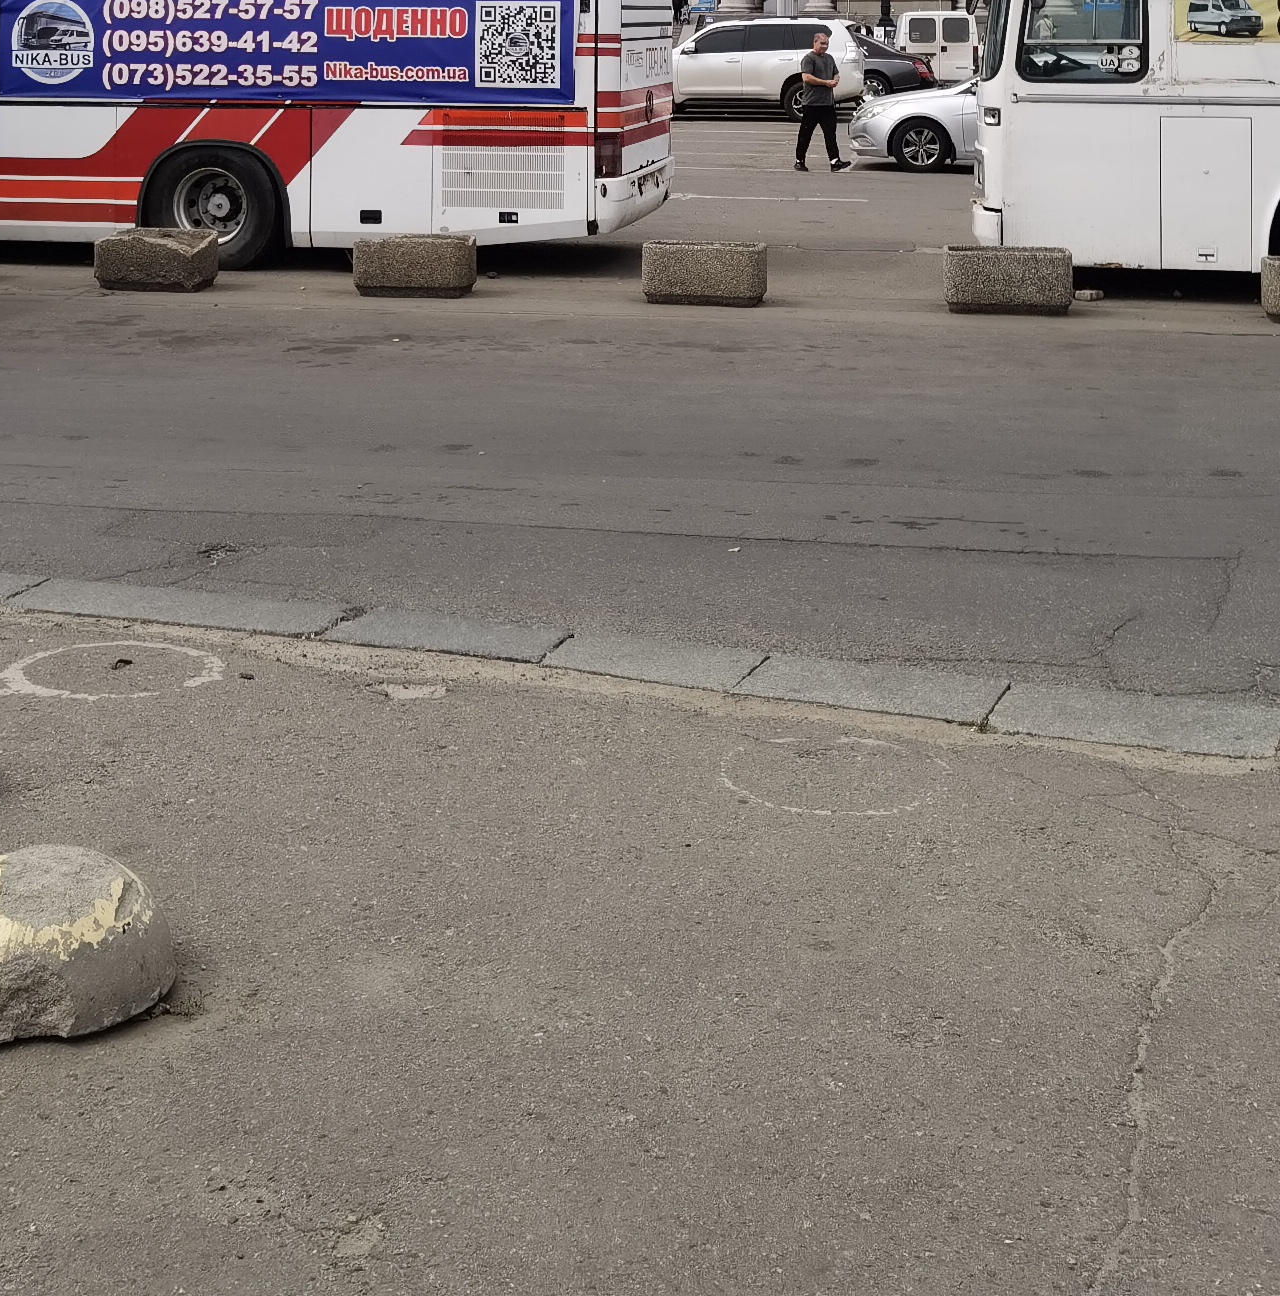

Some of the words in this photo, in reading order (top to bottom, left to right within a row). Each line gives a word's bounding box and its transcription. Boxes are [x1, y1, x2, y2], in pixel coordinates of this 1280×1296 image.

[325, 7, 468, 42] ЩОДЕННО
[102, 29, 318, 57] (095)639-41-42
[14, 53, 92, 66] NIKA-BUS
[324, 61, 469, 83] Nika-bus.com.ua
[1100, 58, 1116, 67] UA
[102, 63, 318, 91] (073)522-35-55
